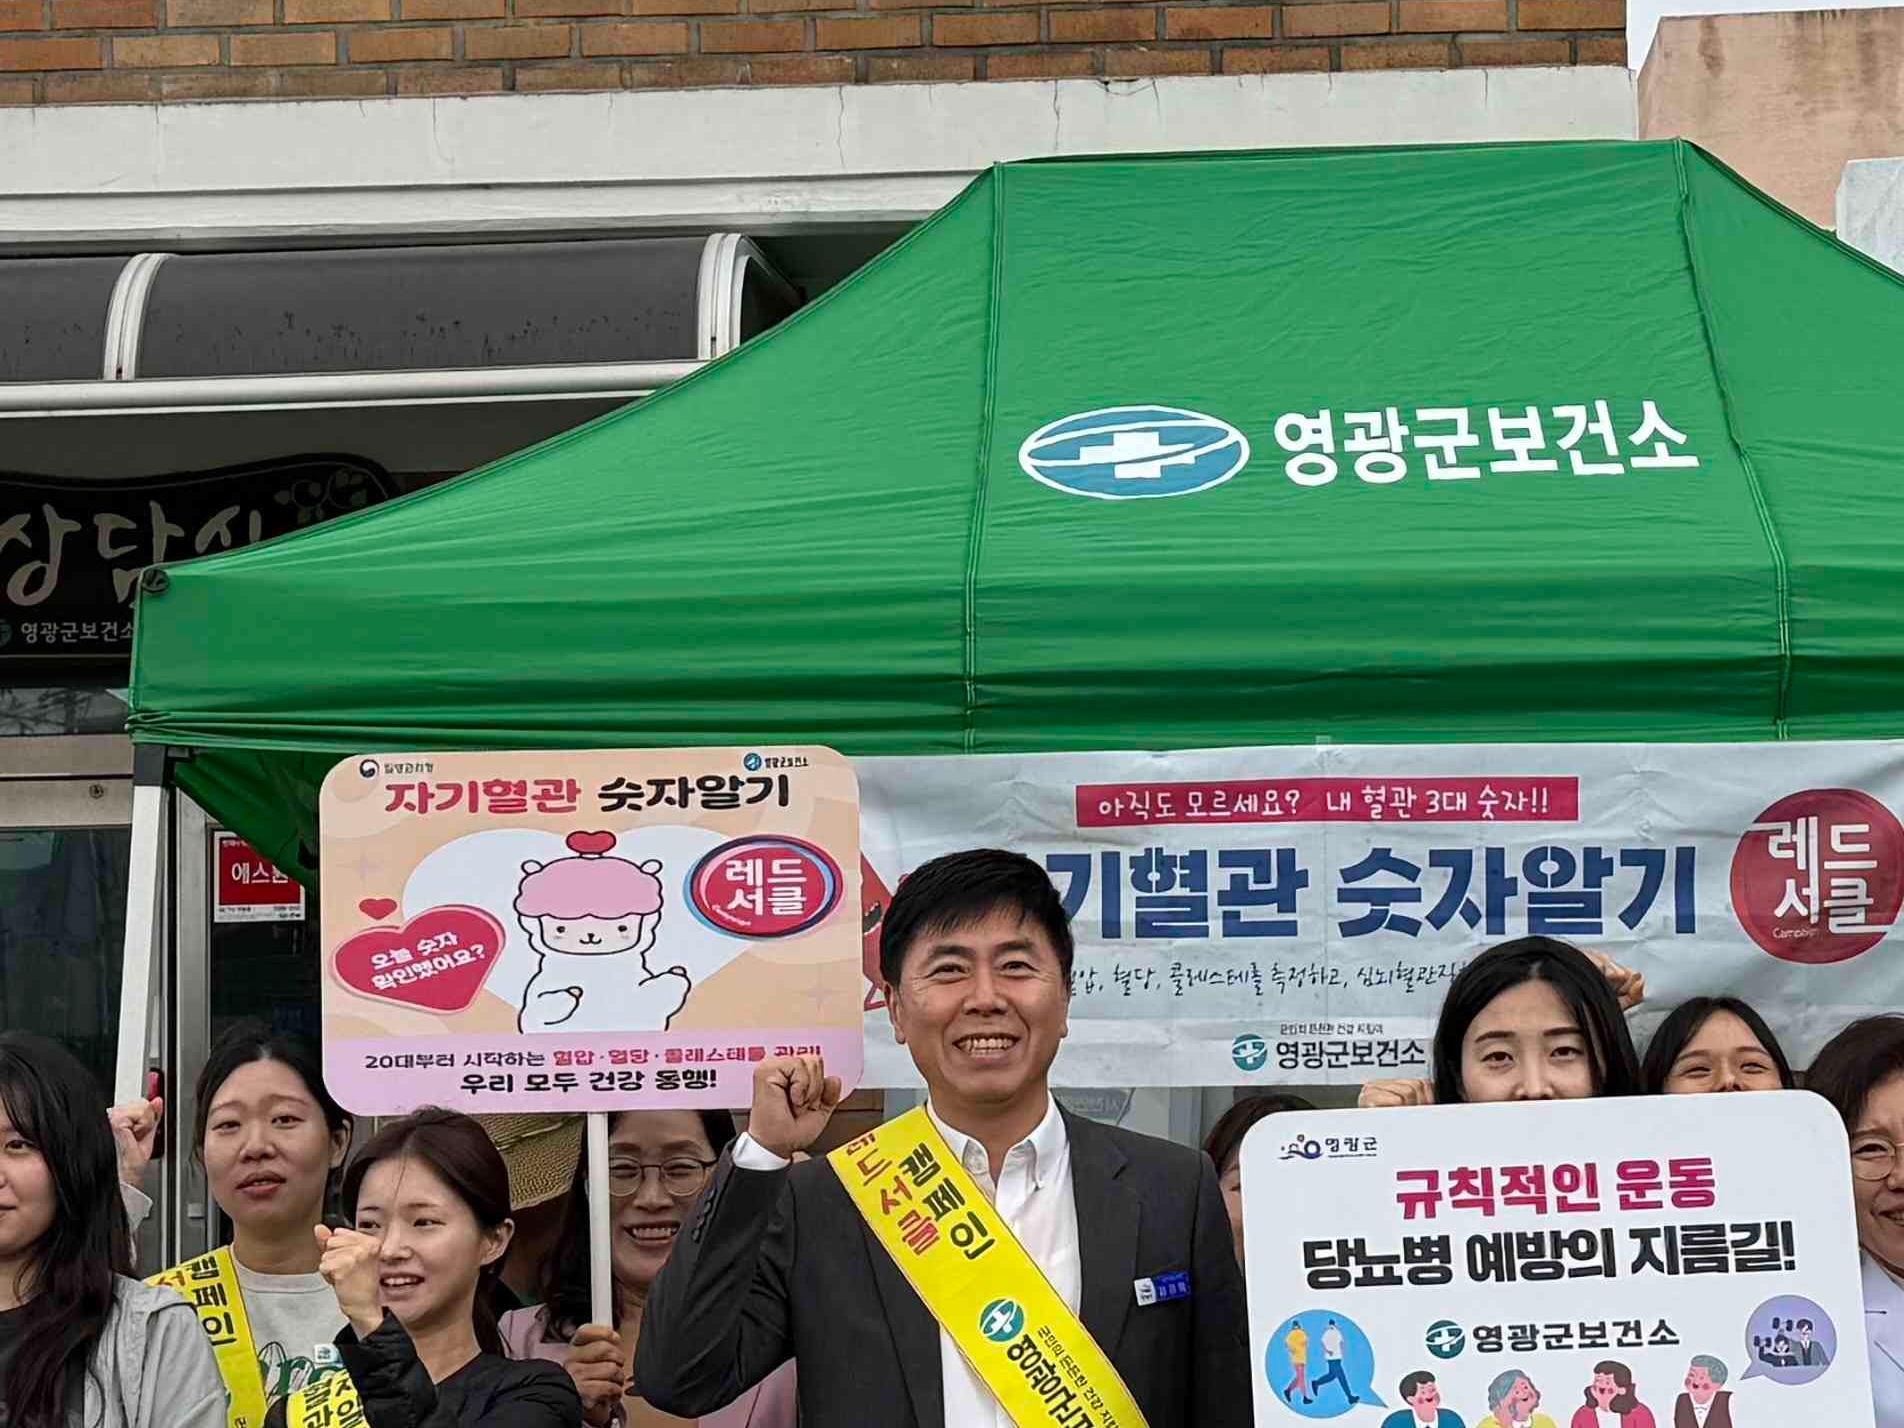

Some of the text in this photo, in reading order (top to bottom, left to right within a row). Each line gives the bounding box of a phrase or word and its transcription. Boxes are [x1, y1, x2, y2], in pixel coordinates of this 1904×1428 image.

[1273, 399, 1700, 486] 영광군보건소
[385, 774, 789, 814] 자기혈관 숫자알기
[1099, 784, 1549, 819] 아직도 모르세요? 내 혈관 3대 숫자!!
[1747, 816, 1878, 870] 레드
[726, 858, 807, 886] 레드
[1044, 845, 1696, 939] 기혈관 숫자알기
[728, 886, 807, 915] 서클
[1773, 877, 1893, 933] 서클
[371, 931, 459, 971] 오늘 숫자
[365, 1053, 455, 1068] 20대부터
[463, 1051, 545, 1067] 시작하는
[1276, 1039, 1426, 1070] 영광군보건소
[460, 1069, 717, 1094] 우리 모두 건강 동행!
[898, 1142, 996, 1260] 캠페인
[1395, 1156, 1716, 1220] 규칙적인 운동
[1302, 1220, 1795, 1290] 당뇨병 예방의 지름길!
[188, 1255, 237, 1346] 캠페인
[1472, 1319, 1681, 1355] 영광군보건소
